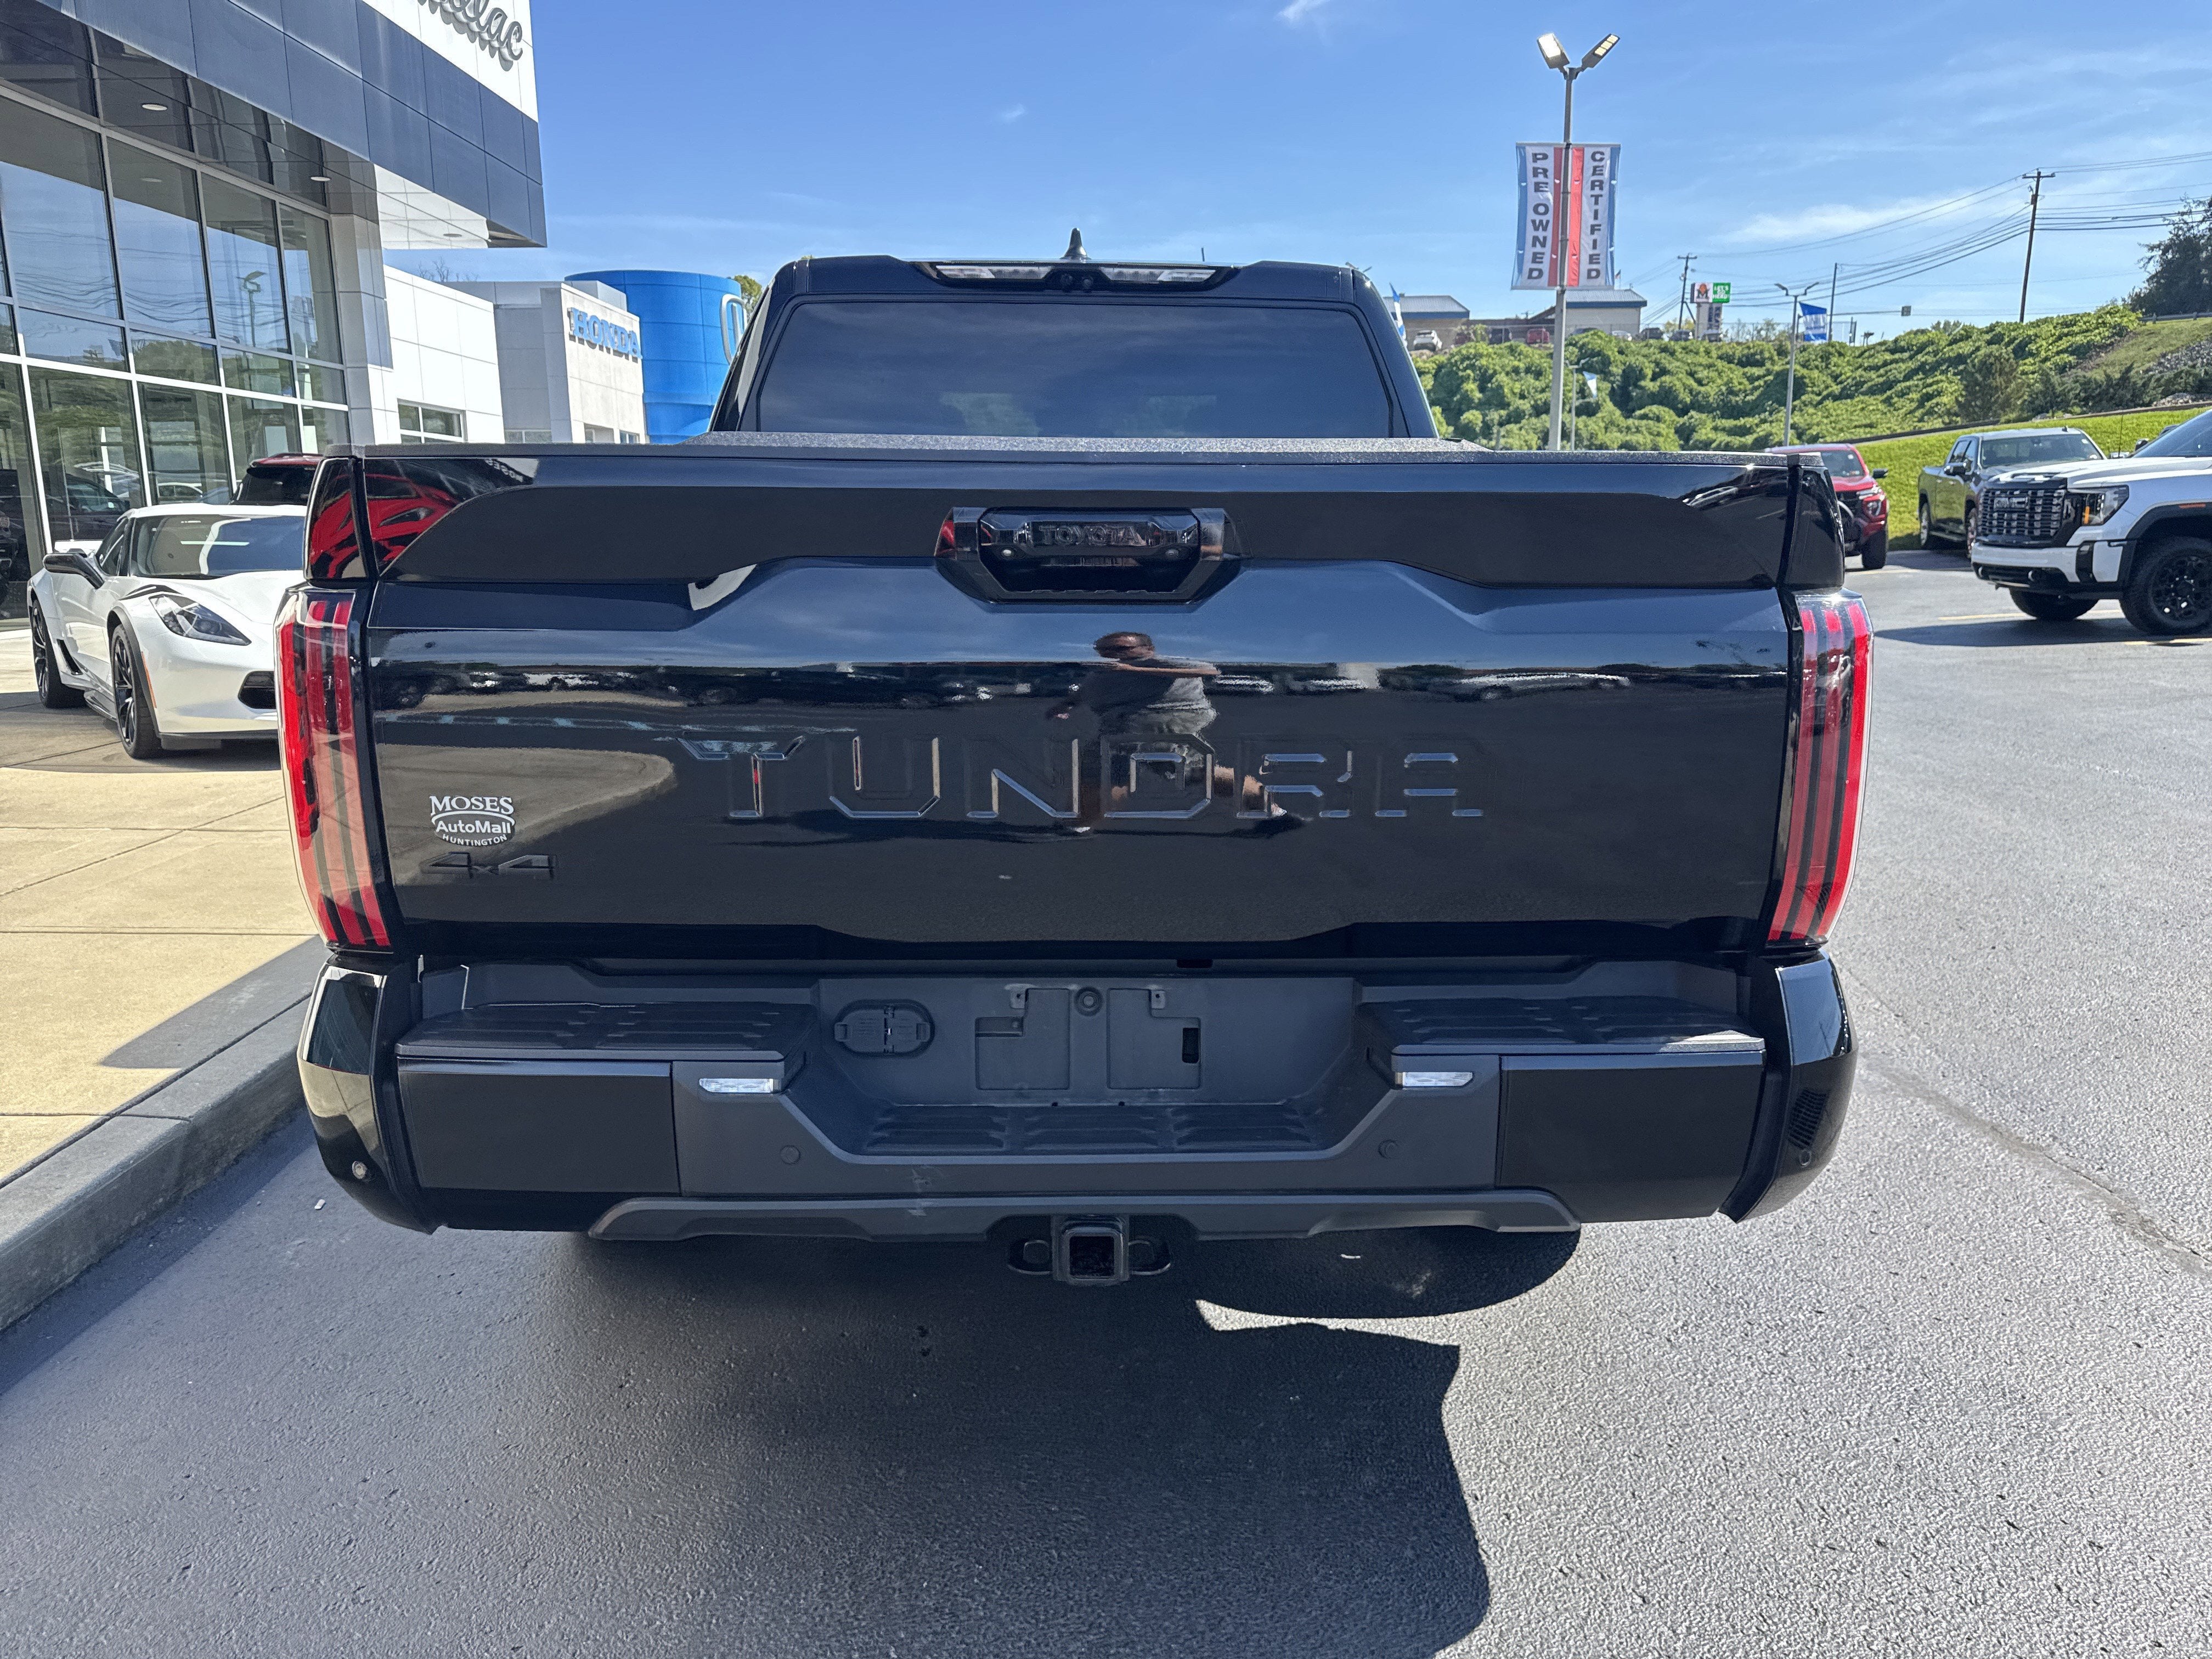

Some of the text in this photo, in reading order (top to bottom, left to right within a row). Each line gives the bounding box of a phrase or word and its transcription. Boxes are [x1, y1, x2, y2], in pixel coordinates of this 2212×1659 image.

[1527, 152, 1550, 280] PRE OWNED
[1587, 151, 1605, 280] CERTIFIED
[567, 307, 642, 359] HONDA
[1039, 525, 1146, 546] TOYOTA
[678, 732, 1485, 820] TUNDRA
[429, 795, 515, 816] MOSES
[436, 820, 512, 833] AutoMall
[442, 833, 507, 847] HUNTINGTON
[419, 851, 556, 879] 4x4
